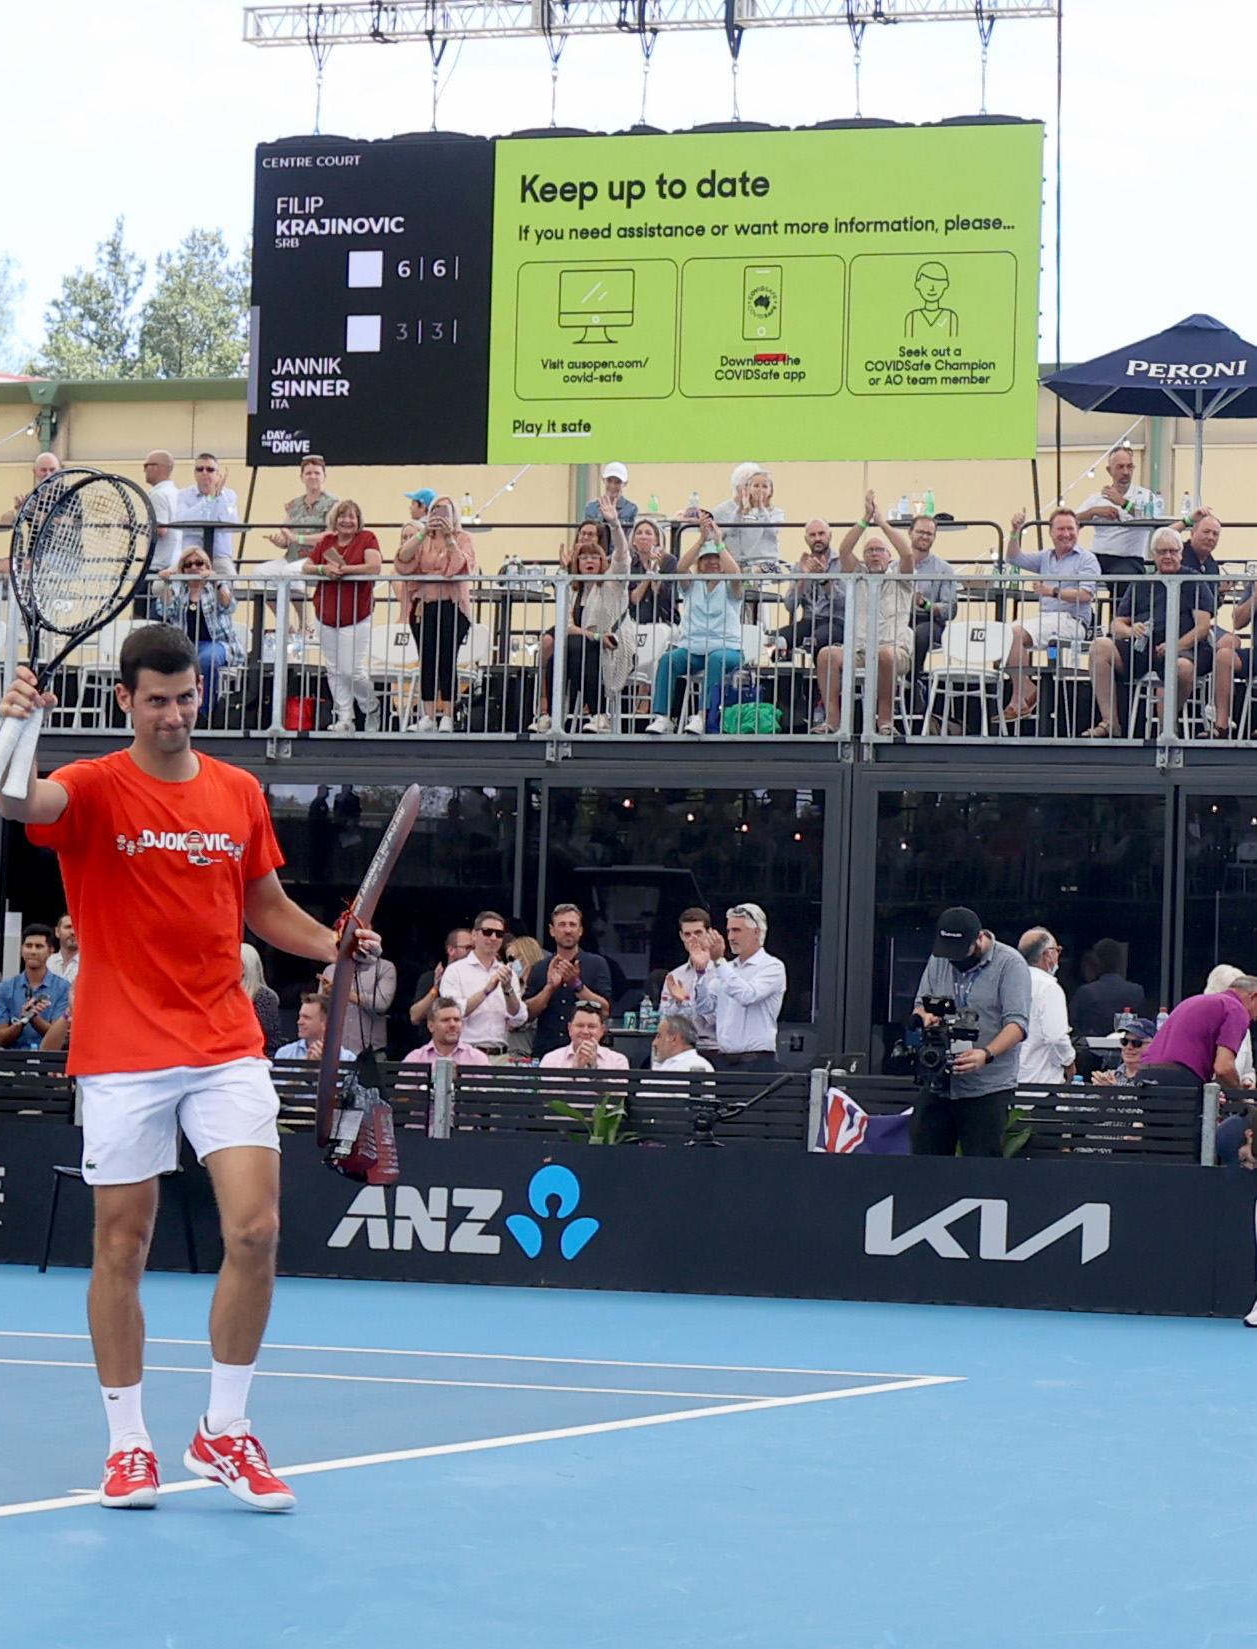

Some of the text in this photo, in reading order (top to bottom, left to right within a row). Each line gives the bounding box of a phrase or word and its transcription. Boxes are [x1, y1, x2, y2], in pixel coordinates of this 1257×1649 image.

[262, 155, 361, 168] CENTRE COURT
[520, 169, 770, 210] Keep up to date
[276, 196, 324, 215] FILIP
[276, 216, 405, 236] KRAJINOVIC
[519, 214, 1015, 245] If you need assistance or want more information, please...
[275, 238, 300, 248] SRB
[398, 259, 446, 278] 6 6
[396, 322, 443, 340] 3 3
[783, 354, 801, 365] the
[899, 346, 961, 357] Seek out a
[271, 357, 342, 376] JANNIK
[541, 359, 564, 370] Visit
[864, 359, 996, 376] COVIDSafe Champion
[1125, 359, 1248, 378] PERONI
[715, 368, 806, 383] COVIDSafe app
[868, 374, 991, 386] or AO team member
[270, 379, 350, 398] SINNER
[270, 399, 290, 410] ITA
[266, 430, 286, 440] DAY
[512, 419, 591, 437] Play it safe
[272, 440, 310, 453] DRIVE
[972, 629, 986, 641] 10
[327, 1185, 503, 1255] ANZ
